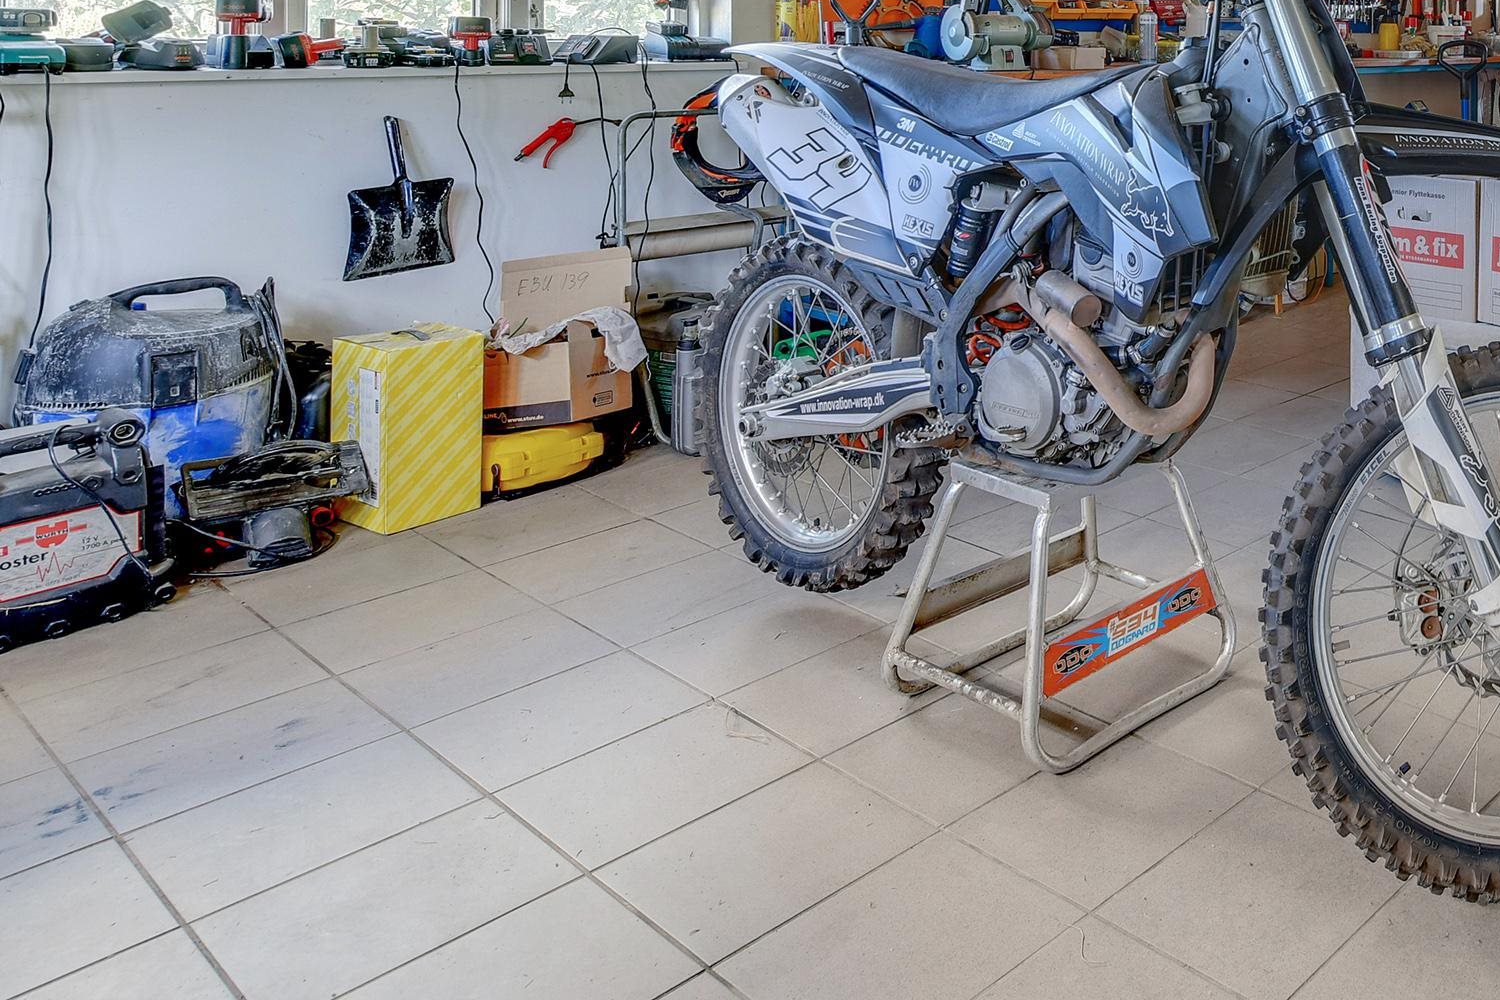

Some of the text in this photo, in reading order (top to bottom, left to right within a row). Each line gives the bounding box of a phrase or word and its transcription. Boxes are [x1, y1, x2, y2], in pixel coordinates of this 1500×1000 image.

[897, 117, 916, 133] 3M
[992, 134, 1013, 149] Castrol
[1395, 134, 1484, 146] INNOVATION
[1100, 154, 1125, 186] WRAP
[1409, 190, 1446, 200] Flyttekasse
[902, 214, 934, 238] HEXIS
[1365, 203, 1378, 232] Racing
[1376, 234, 1397, 282] Suspension
[1414, 235, 1430, 256] &
[1433, 237, 1459, 259] fix
[1113, 271, 1144, 307] HEXIS
[800, 392, 885, 414] www.innovation-wrap.dk
[1450, 411, 1473, 453] DENNISON
[1454, 409, 1469, 433] AVERY
[1360, 450, 1390, 485] EXCEL
[0, 551, 49, 571] oster
